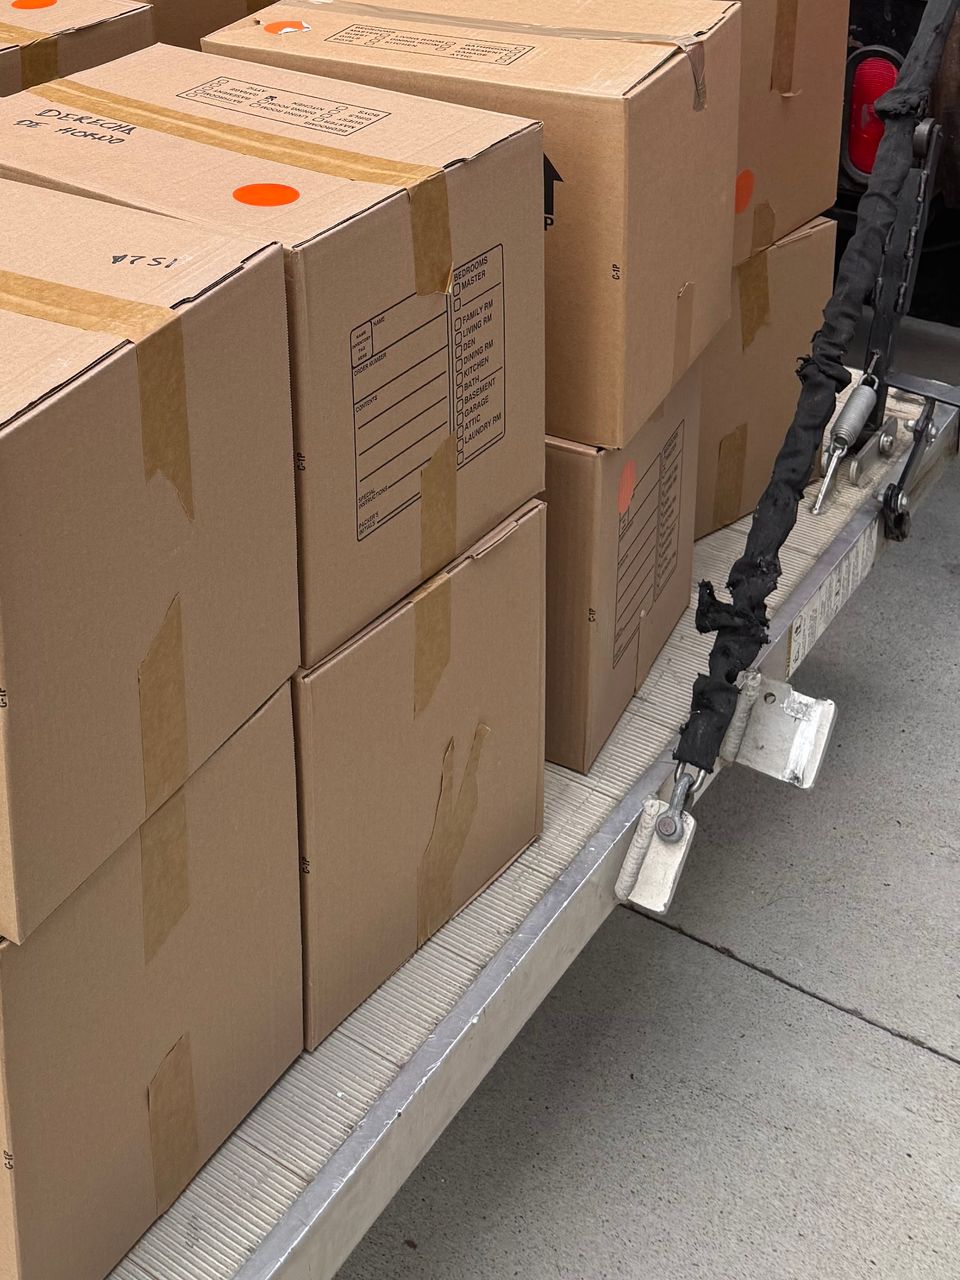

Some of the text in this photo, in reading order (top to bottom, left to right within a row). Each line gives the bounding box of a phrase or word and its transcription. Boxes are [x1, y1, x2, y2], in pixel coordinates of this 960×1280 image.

[202, 92, 243, 105] BATHROOM
[214, 89, 251, 100] BASEMENT
[260, 105, 309, 119] LIVING ROOM
[268, 102, 317, 115] DINING ROOM
[291, 101, 325, 111] KITCHEN
[13, 120, 49, 128] DE
[35, 109, 137, 135] DERECHA
[324, 120, 357, 129] MASTER
[348, 113, 372, 122] GIRLS
[303, 121, 348, 133] BEDROOMS
[453, 256, 488, 282] BEDROOMS
[461, 271, 486, 290] MASTER
[463, 299, 493, 325] FAMILY RM
[373, 316, 385, 327] NAME
[463, 314, 492, 337] LIVING RM
[463, 337, 476, 351] DEN
[463, 340, 494, 364] DINING RM
[354, 352, 386, 377] ORDER NUMBER
[464, 356, 489, 378] KITCHEN
[464, 376, 480, 391] BATH
[464, 377, 496, 404] BASEMENT
[355, 395, 378, 413] CONTENTS
[464, 395, 489, 418] GARAGE
[464, 414, 481, 431] ATTIC
[464, 413, 502, 444] LAUNDRY RM
